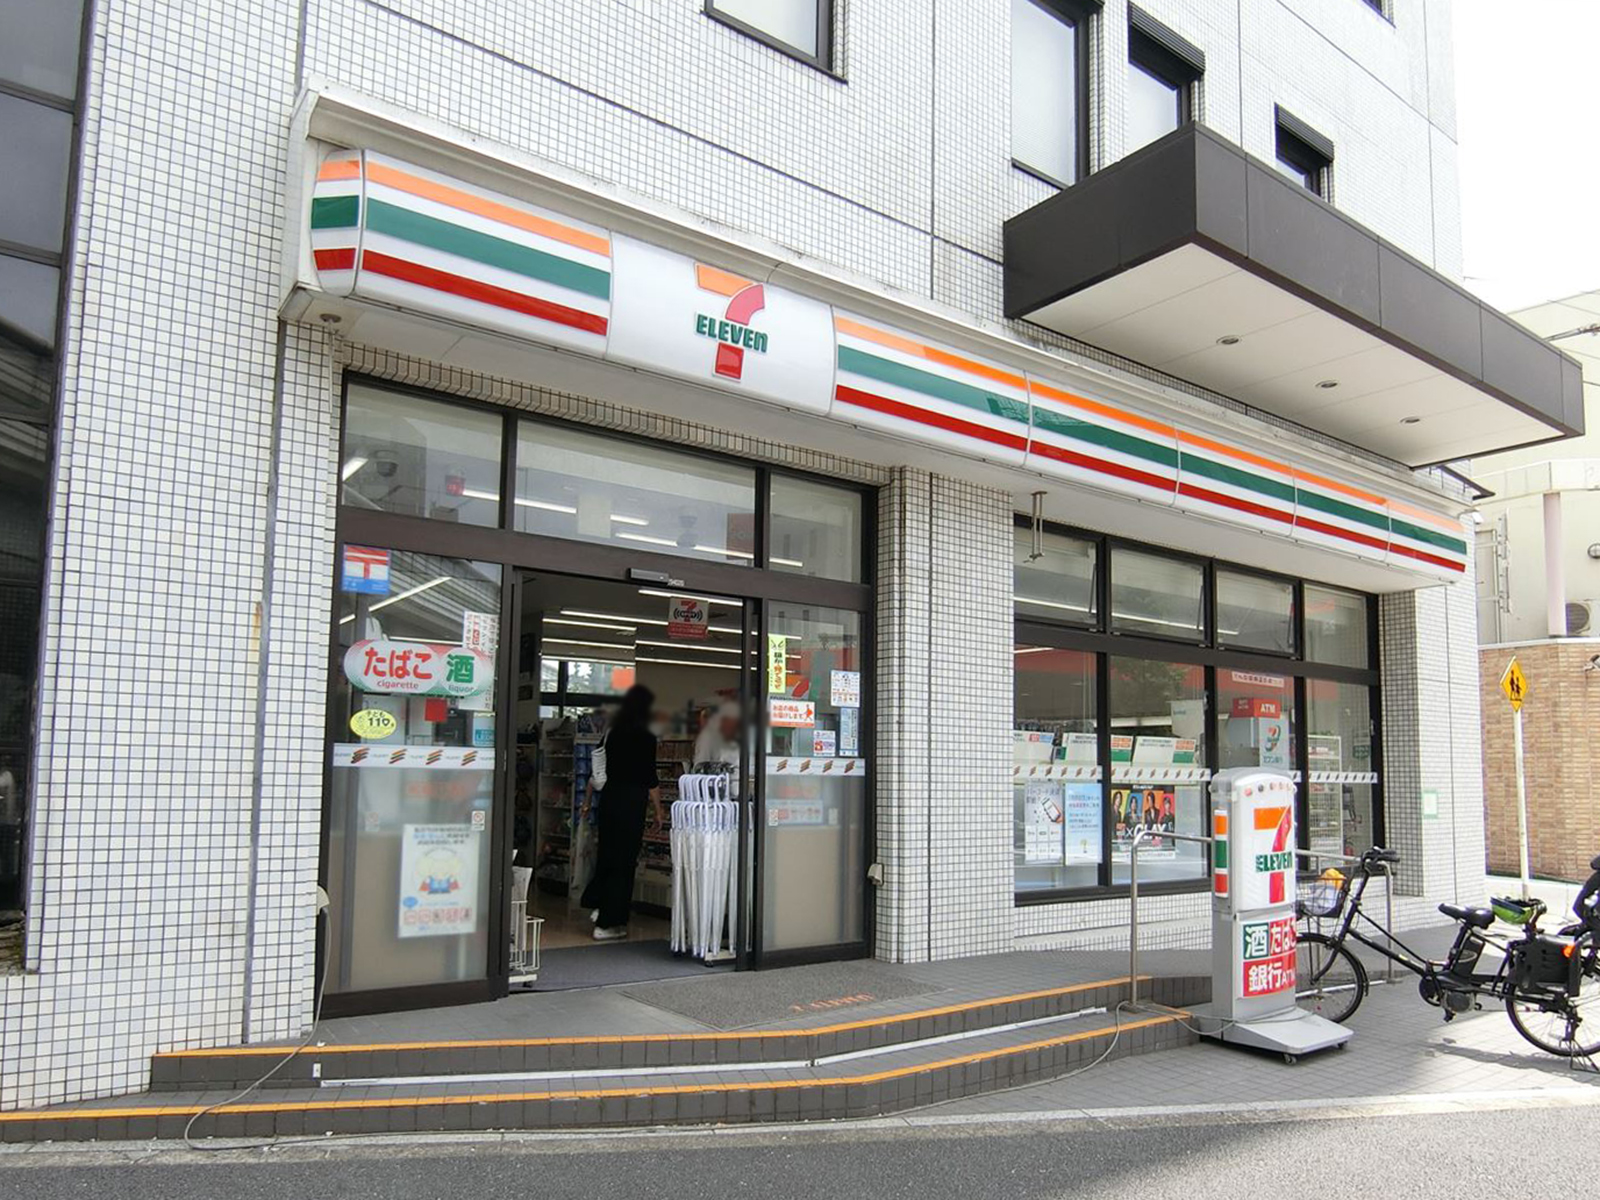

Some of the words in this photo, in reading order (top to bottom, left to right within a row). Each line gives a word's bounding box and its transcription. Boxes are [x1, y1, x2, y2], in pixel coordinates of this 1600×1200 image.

[364, 647, 433, 679] たばこ
[446, 653, 475, 683] 酒
[376, 680, 420, 691] cigarette
[448, 684, 475, 693] liquor
[1260, 703, 1276, 714] ATM
[1245, 925, 1268, 958] 酒
